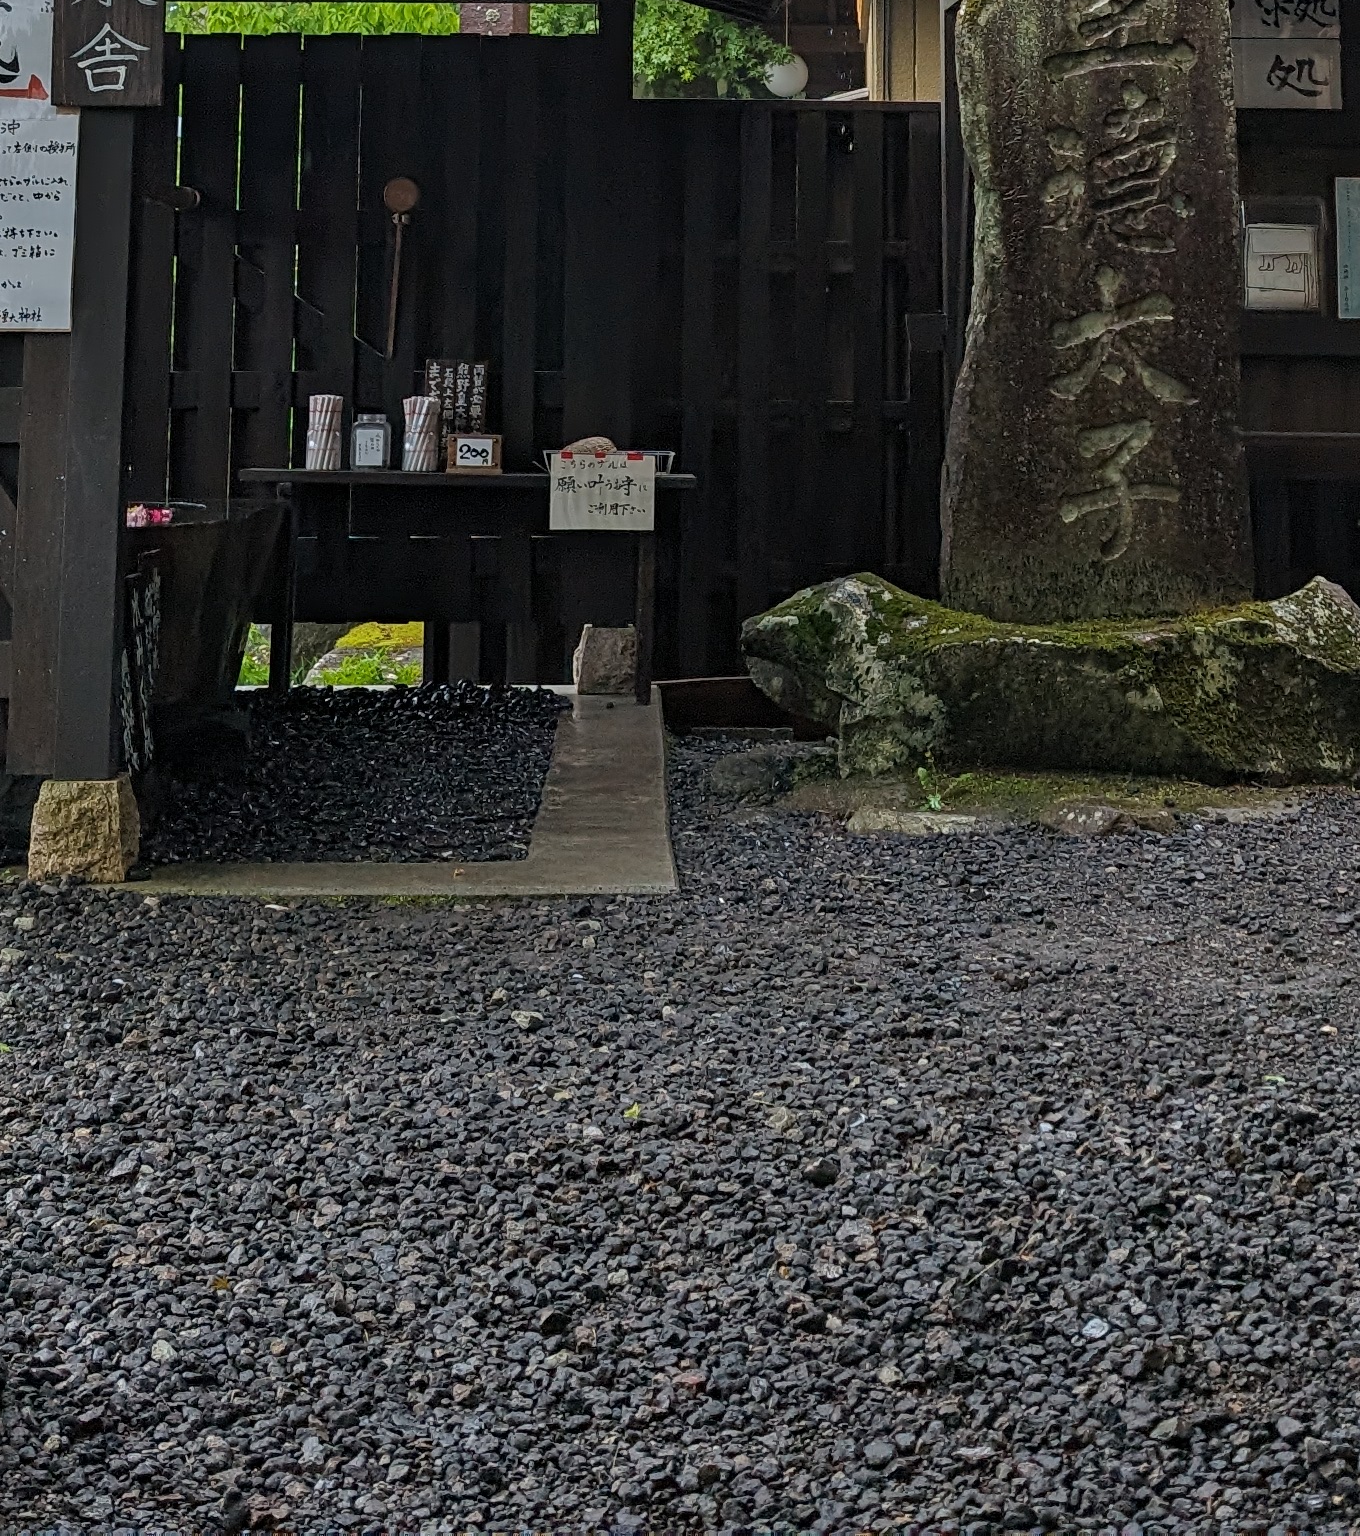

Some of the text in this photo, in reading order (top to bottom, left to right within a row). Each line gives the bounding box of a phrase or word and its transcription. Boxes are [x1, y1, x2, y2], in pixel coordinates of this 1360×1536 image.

[469, 364, 485, 432] 両替が必要な
[459, 444, 489, 459] 200
[588, 502, 646, 516] ご利用下さい
